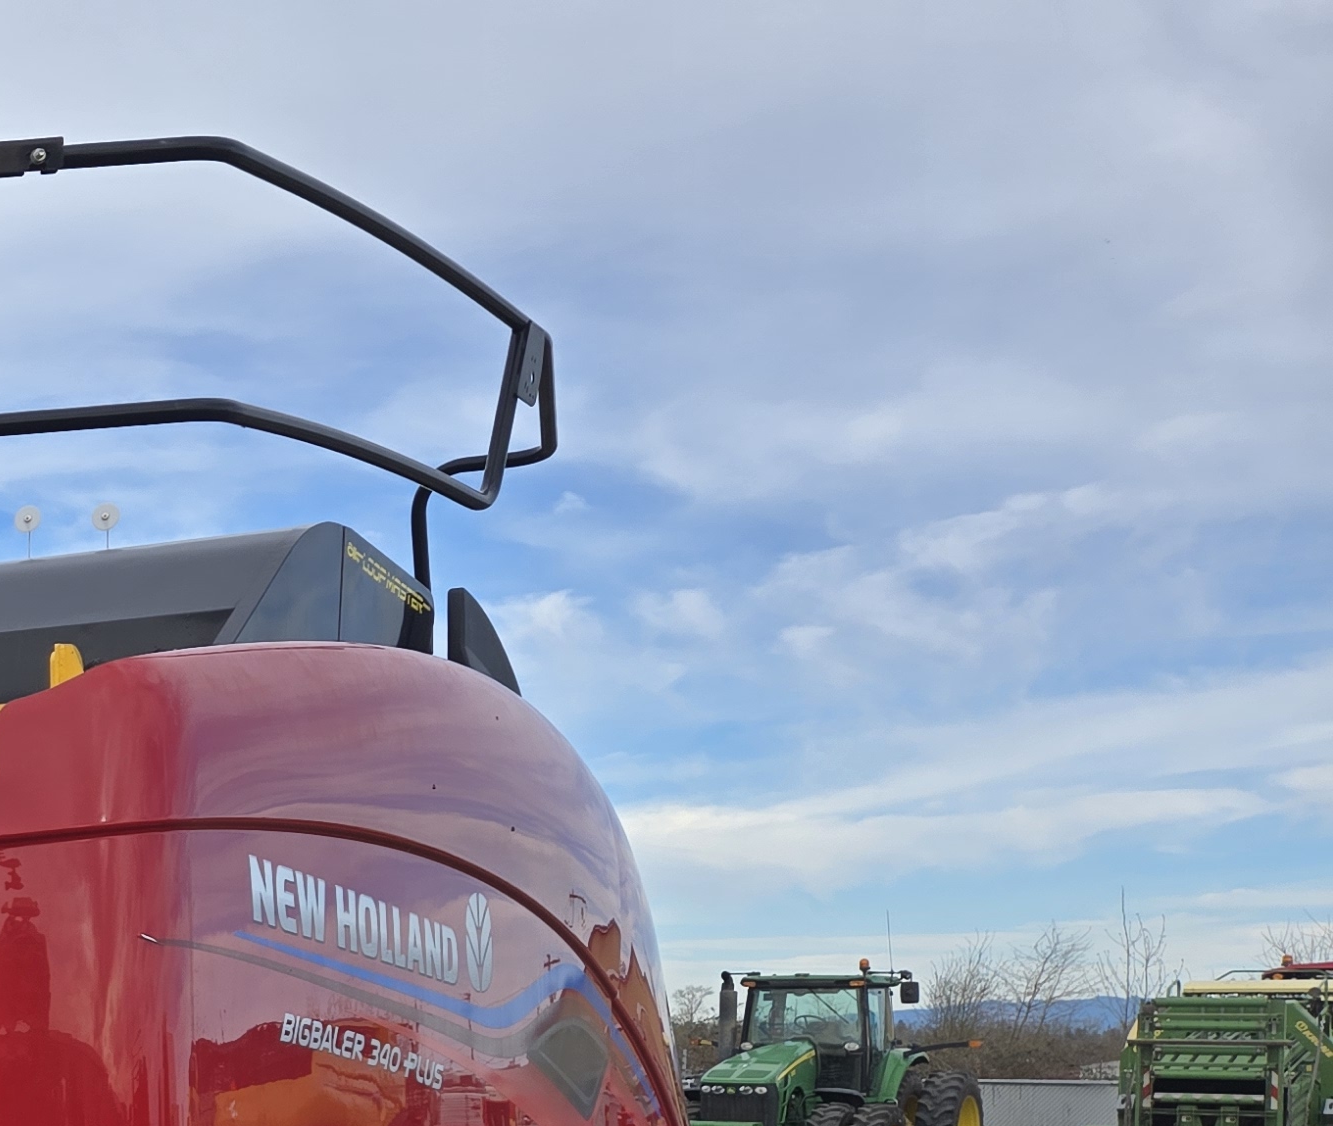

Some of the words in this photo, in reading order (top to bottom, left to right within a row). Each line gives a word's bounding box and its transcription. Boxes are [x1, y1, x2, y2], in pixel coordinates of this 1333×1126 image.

[248, 855, 326, 942] NEW
[335, 885, 459, 984] HOLLAND
[280, 1012, 365, 1062] BIGBALER
[366, 1038, 401, 1074] 340
[403, 1052, 444, 1090] PLUS
